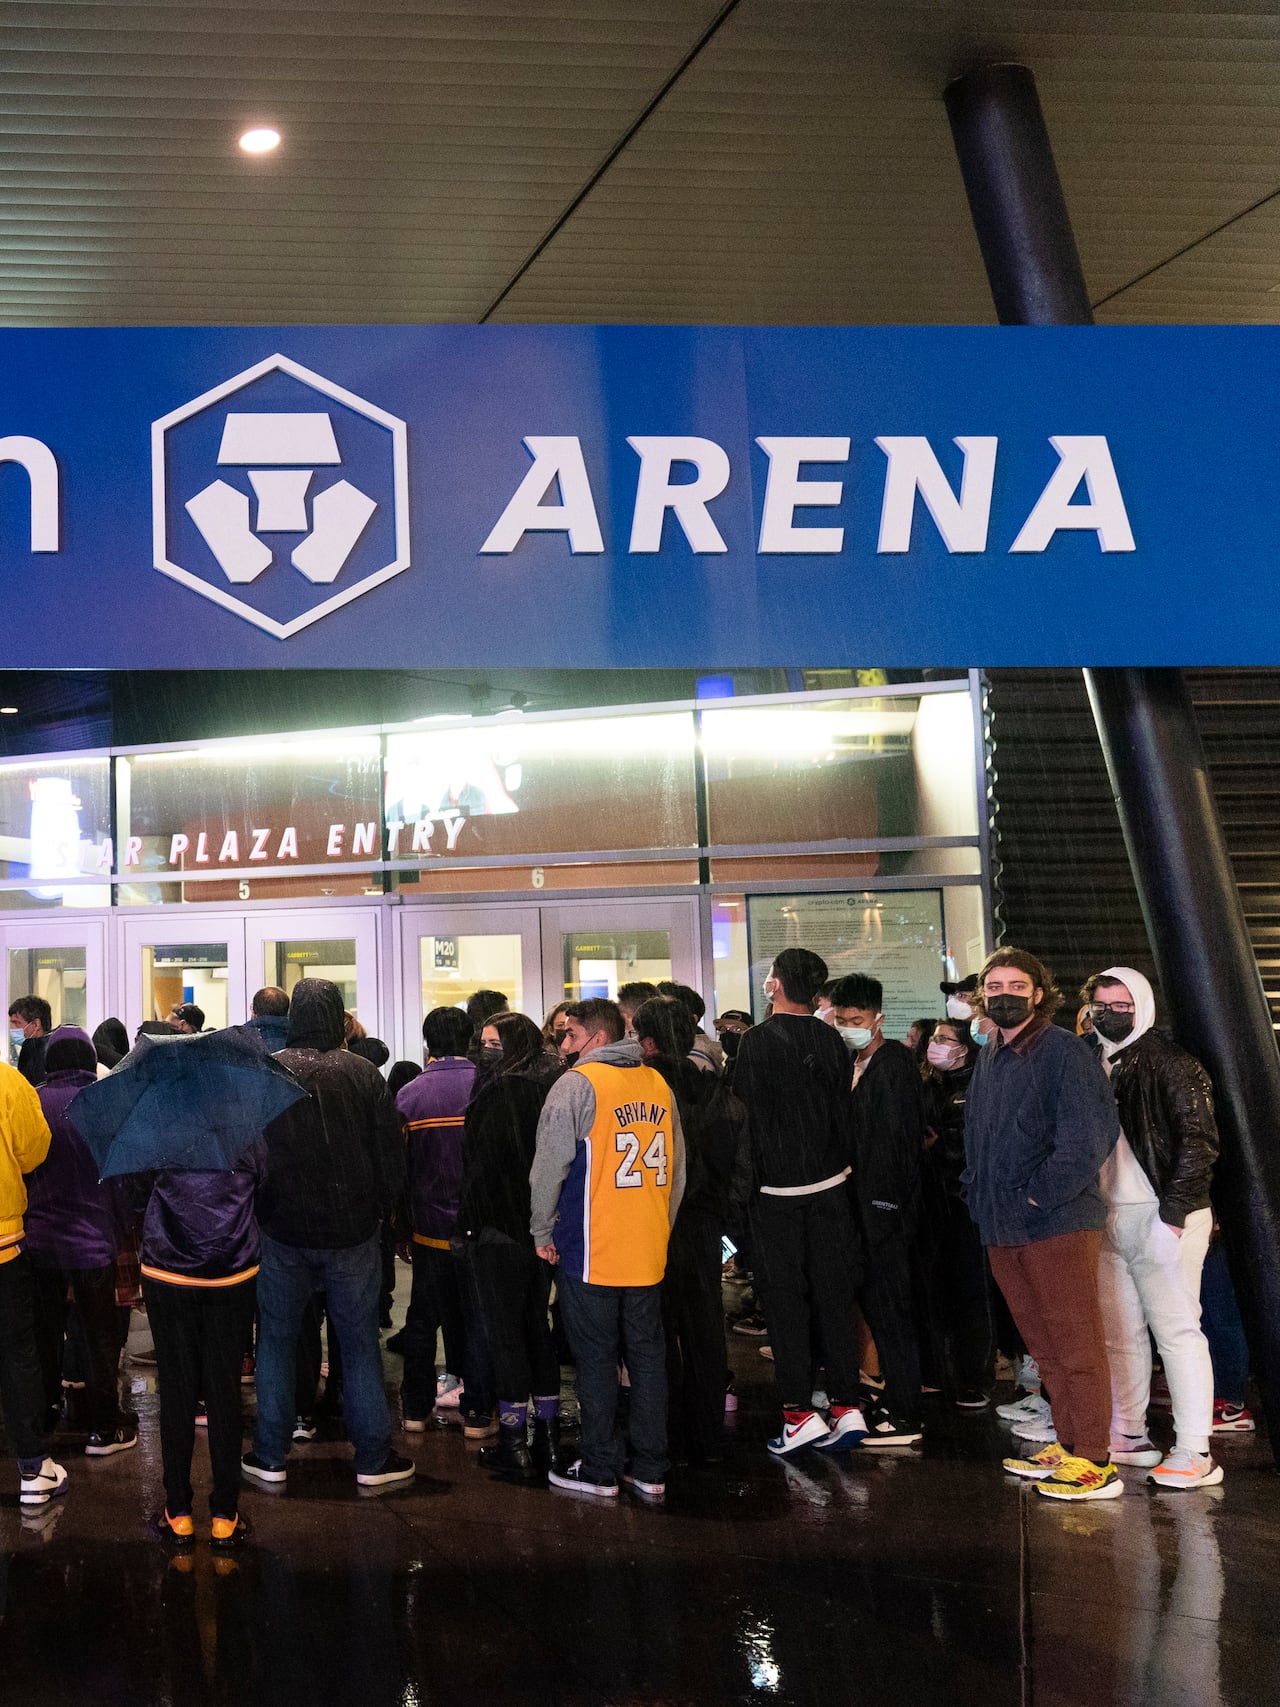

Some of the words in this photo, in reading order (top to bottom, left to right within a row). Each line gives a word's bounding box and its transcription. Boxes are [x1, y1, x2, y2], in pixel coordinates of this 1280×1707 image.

[478, 433, 1138, 556] ARENA
[169, 827, 299, 866] PLAZA
[326, 816, 467, 857] ENTRY
[238, 880, 251, 900] 5
[531, 866, 545, 889] 6
[435, 940, 455, 957] M20
[613, 1101, 669, 1128] BRYANT
[615, 1130, 669, 1189] 24
